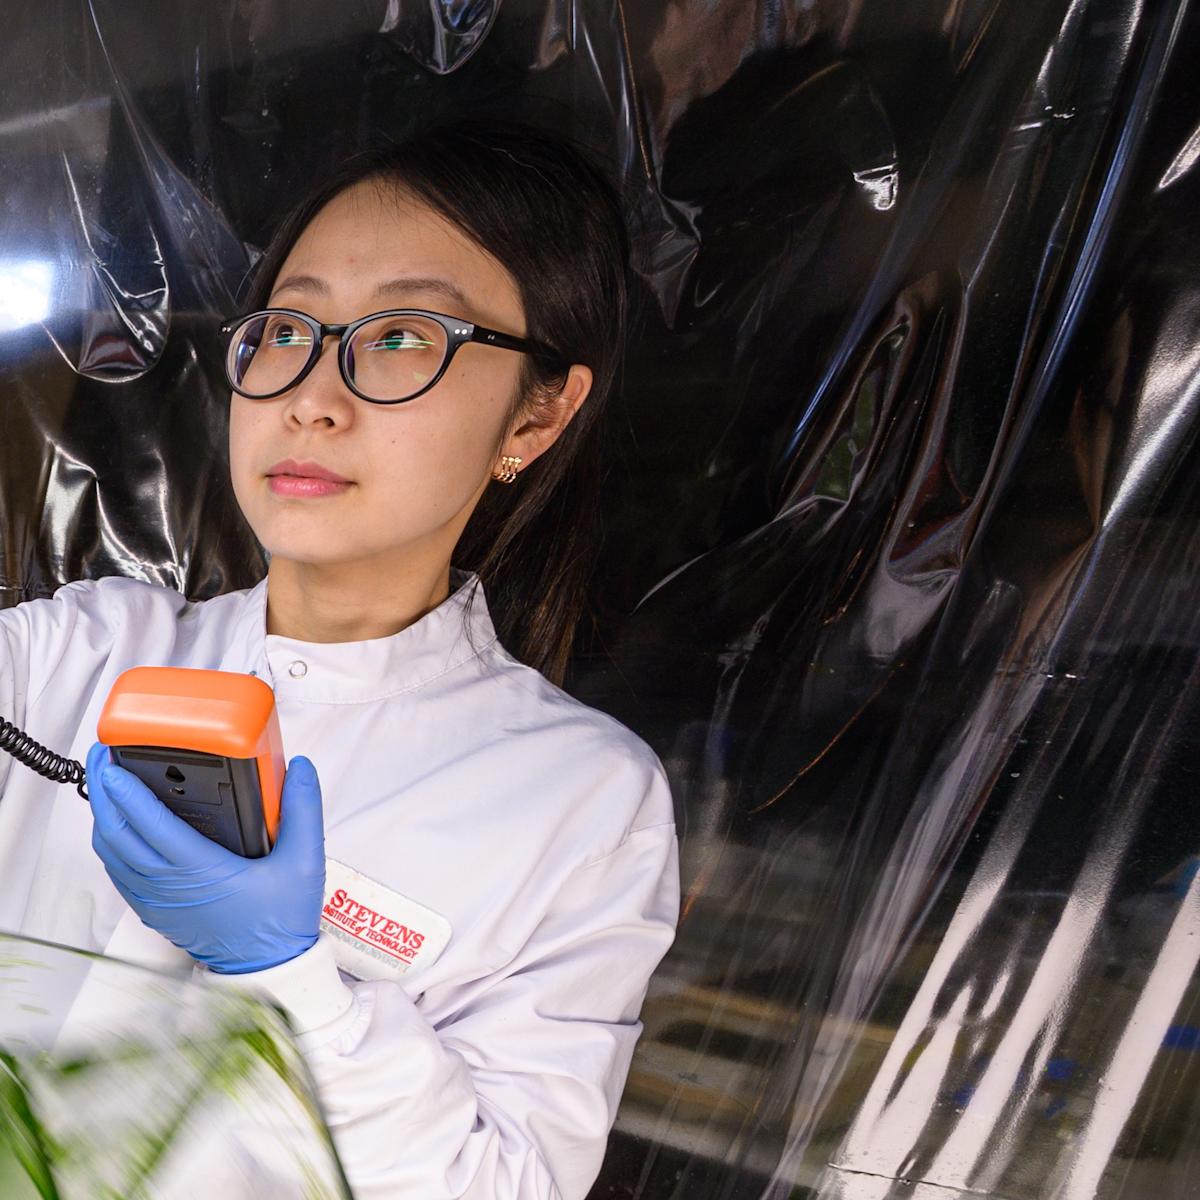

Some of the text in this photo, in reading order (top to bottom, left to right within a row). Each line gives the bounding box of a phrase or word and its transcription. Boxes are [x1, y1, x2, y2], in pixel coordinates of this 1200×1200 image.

[323, 904, 357, 928] INSTITUTE
[355, 925, 366, 935] of
[366, 929, 418, 958] TECHNOLOGY
[330, 889, 425, 949] STEVENS
